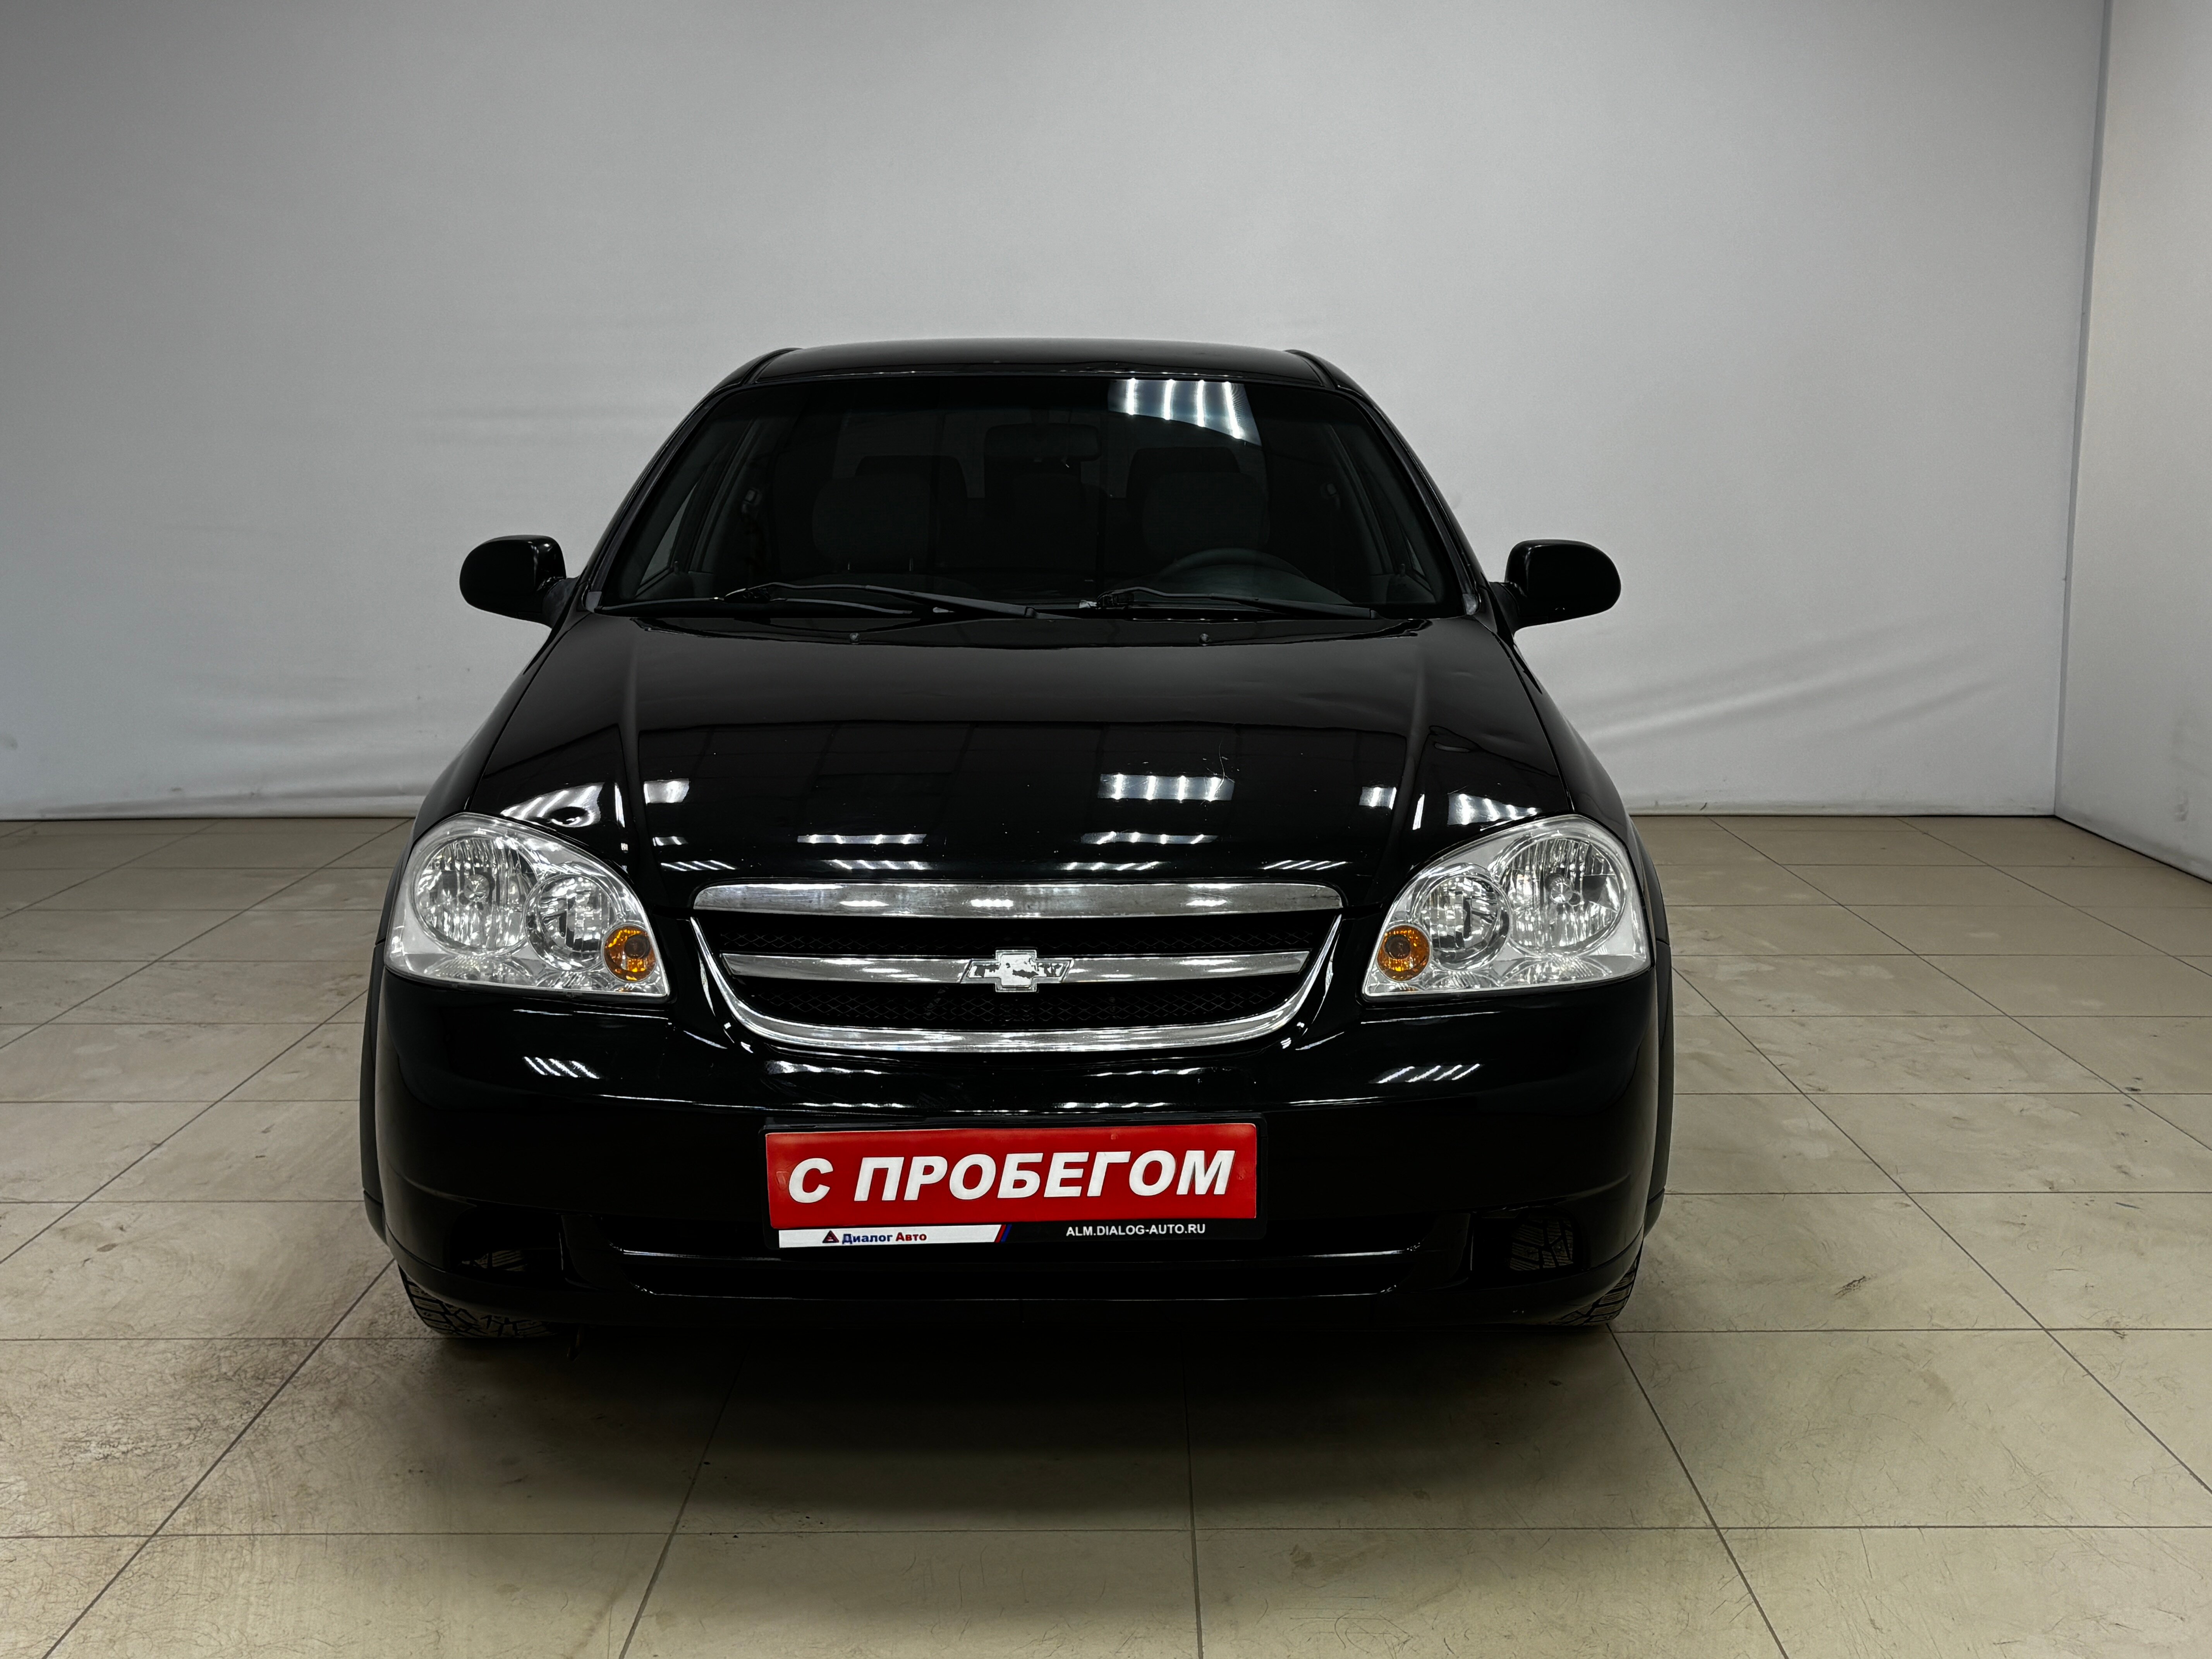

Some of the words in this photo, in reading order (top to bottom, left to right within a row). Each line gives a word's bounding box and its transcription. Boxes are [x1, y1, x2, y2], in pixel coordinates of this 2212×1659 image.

[789, 1158, 833, 1203] С
[854, 1150, 1235, 1201] ПРОБЕГОМ
[1066, 1224, 1206, 1236] ALM.DIALOG-AUTO.RU
[842, 1233, 893, 1244] Диалог
[895, 1232, 927, 1241] Авто
